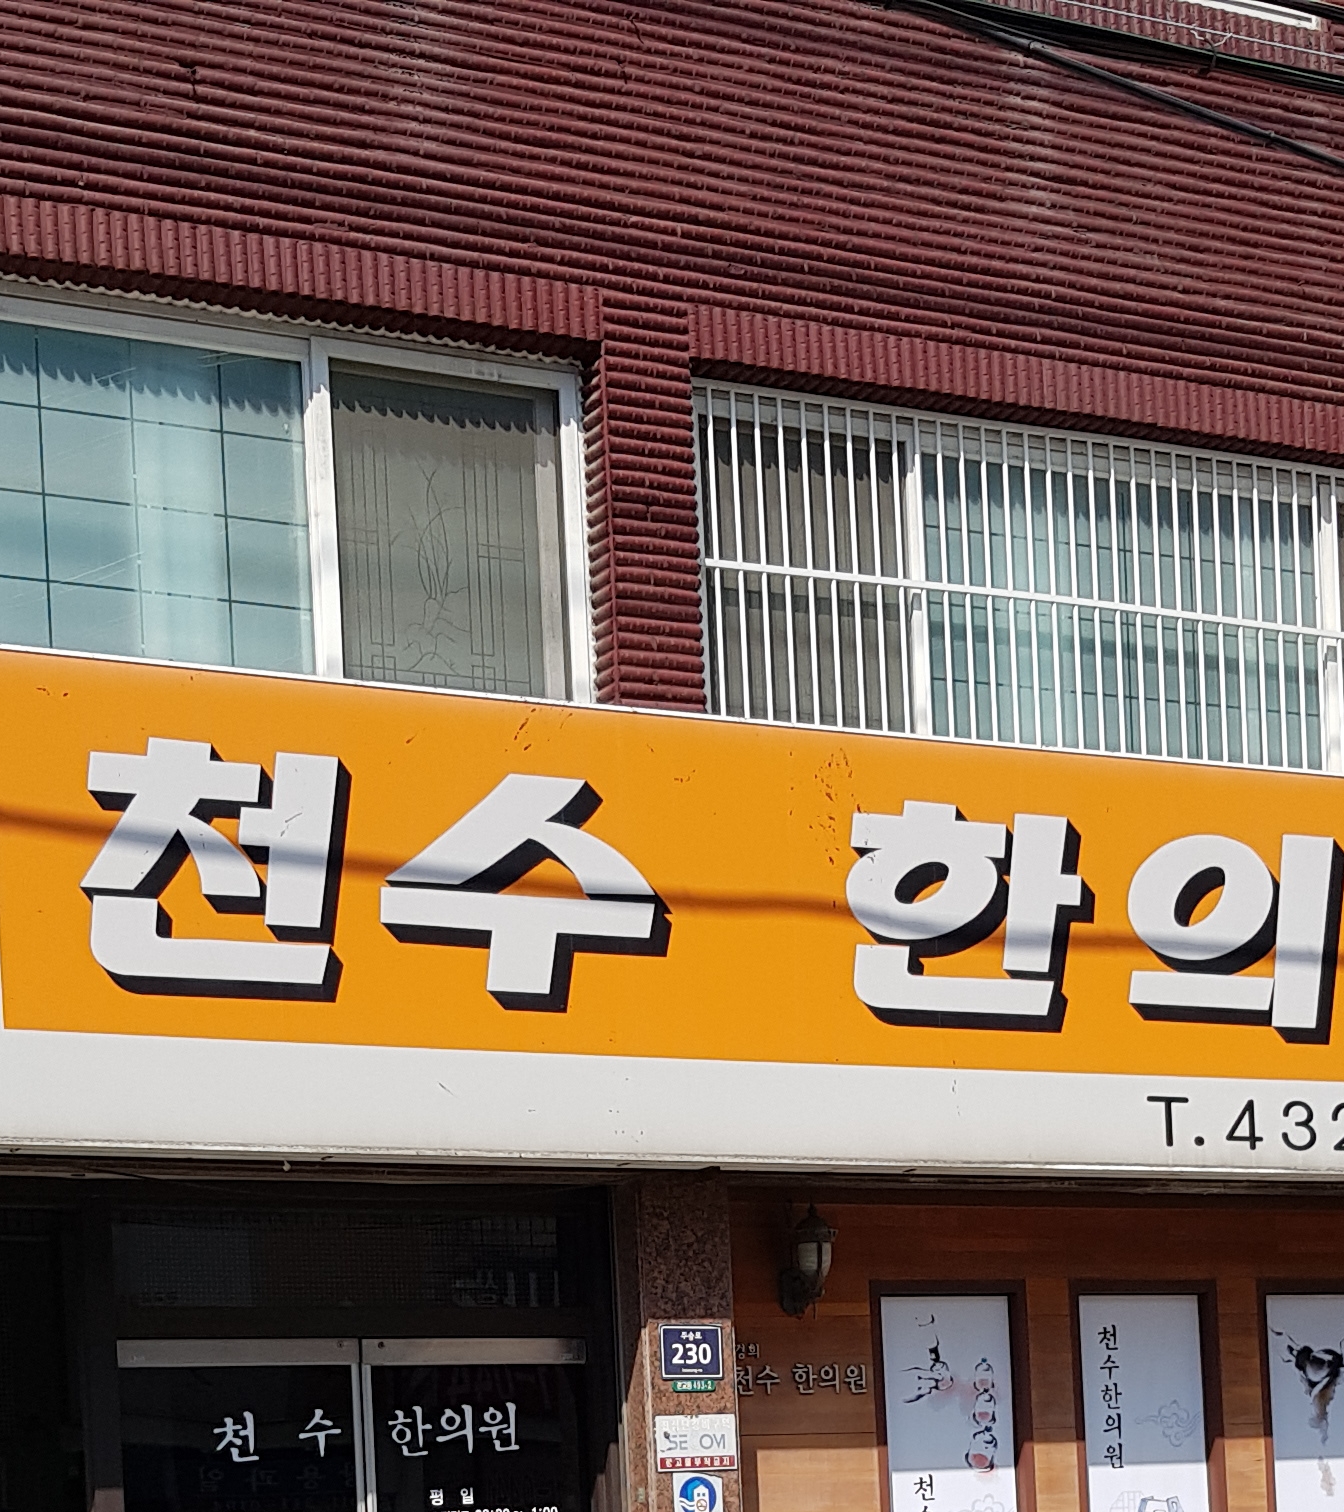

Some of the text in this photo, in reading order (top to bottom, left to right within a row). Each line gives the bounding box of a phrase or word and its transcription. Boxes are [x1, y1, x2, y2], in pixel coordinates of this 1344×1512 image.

[79, 736, 673, 1014] 천수
[671, 1343, 712, 1365] 230
[792, 1361, 868, 1396] 한의원
[1098, 1323, 1125, 1470] 천수한의원
[387, 1401, 521, 1458] 한의원
